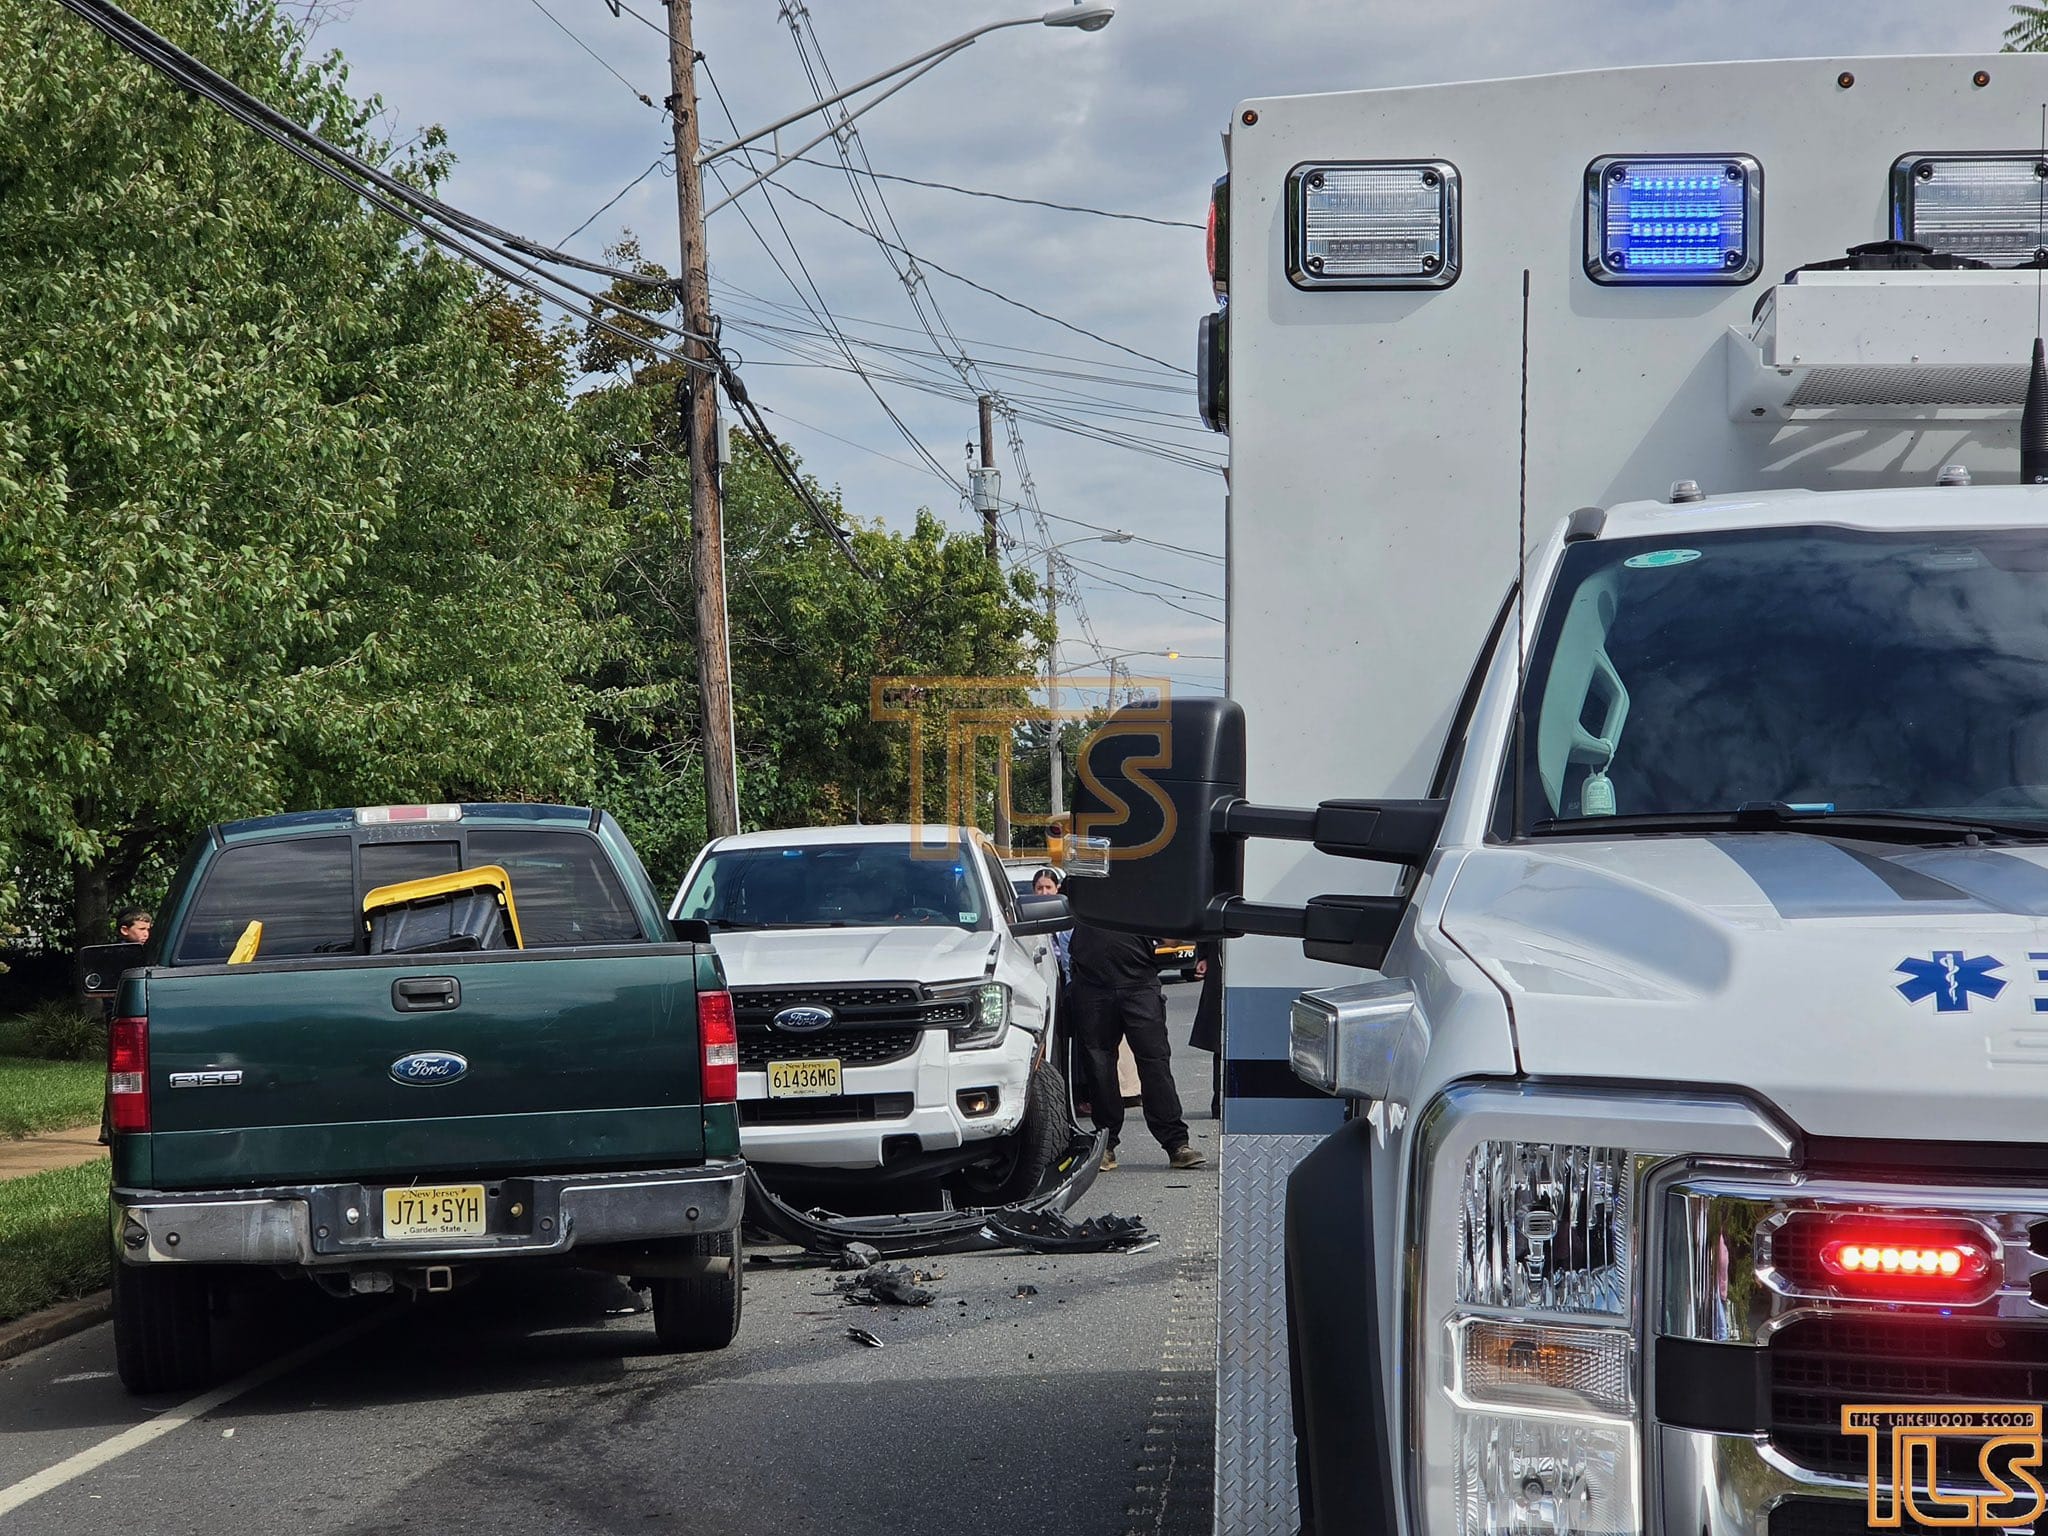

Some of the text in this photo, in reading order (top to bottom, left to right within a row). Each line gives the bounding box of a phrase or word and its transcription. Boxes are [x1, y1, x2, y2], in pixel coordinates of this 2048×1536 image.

[787, 1012, 818, 1026] Ford
[408, 1058, 450, 1077] Ford
[773, 1068, 836, 1088] 61436MG
[409, 1188, 460, 1199] New Jersey
[409, 1226, 438, 1234] Garden
